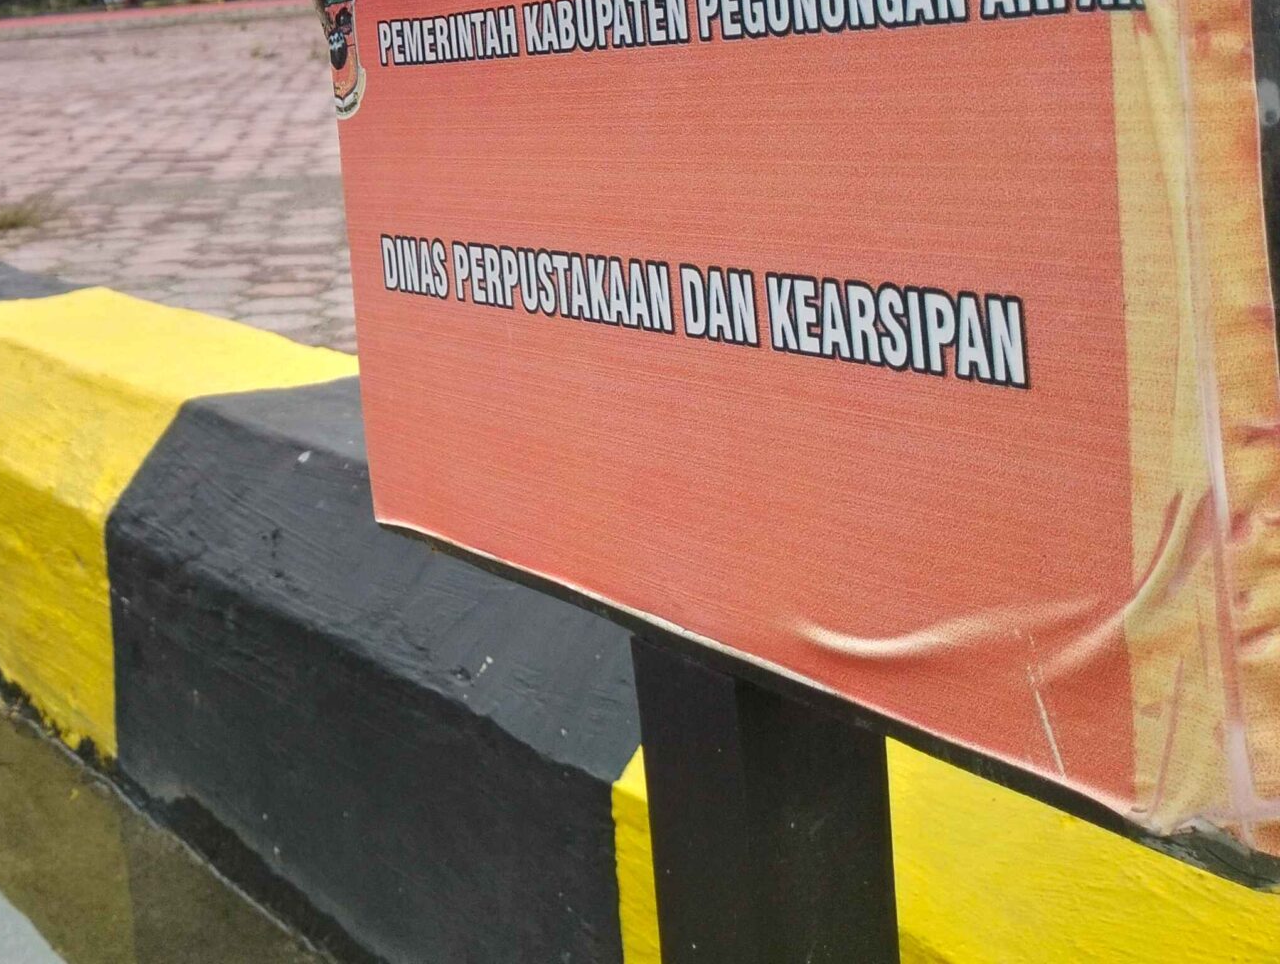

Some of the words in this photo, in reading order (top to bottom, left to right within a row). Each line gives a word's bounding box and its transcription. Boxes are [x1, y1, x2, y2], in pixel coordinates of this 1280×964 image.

[377, 5, 519, 67] PEMERINTAH
[380, 233, 448, 299] DINAS
[451, 240, 675, 334] PERPUSTAKAAN
[679, 263, 761, 348] DAN
[765, 272, 1031, 389] KEARSIPAN
